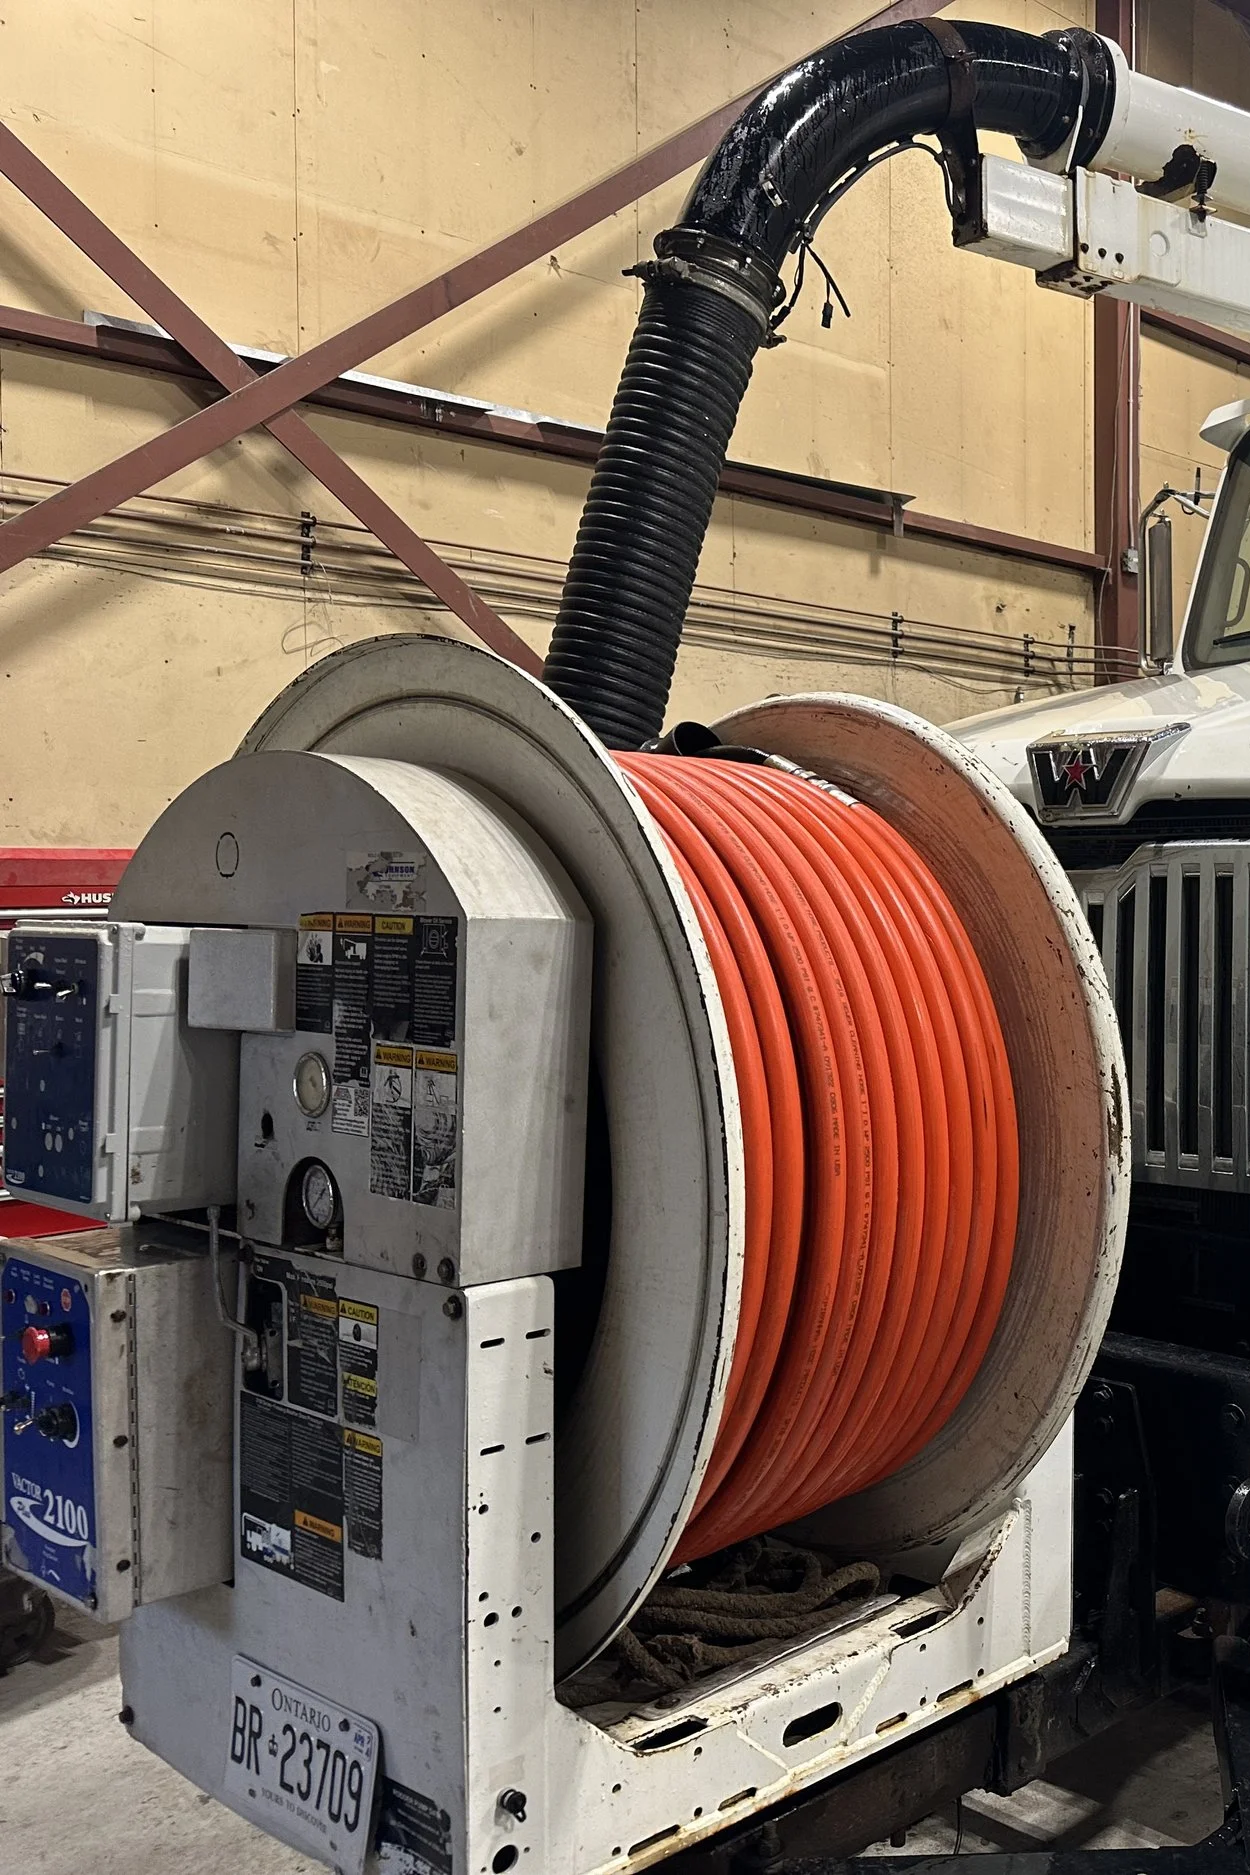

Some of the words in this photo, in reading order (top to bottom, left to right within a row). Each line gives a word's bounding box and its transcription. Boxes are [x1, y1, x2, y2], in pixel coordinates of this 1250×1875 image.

[81, 892, 114, 904] HUS
[344, 917, 371, 929] WARNING
[381, 920, 406, 931] CAUTION
[383, 1052, 411, 1064] WARNING
[426, 1057, 455, 1069] WARNING
[347, 1306, 375, 1321] CAUTION
[11, 1472, 43, 1501] VACTOR
[43, 1489, 89, 1540] 2100
[271, 1688, 331, 1733] ONTARIO
[230, 1695, 263, 1776] BR
[279, 1723, 364, 1833] 23709
[261, 1787, 284, 1807] YOURS
[286, 1801, 296, 1813] TO
